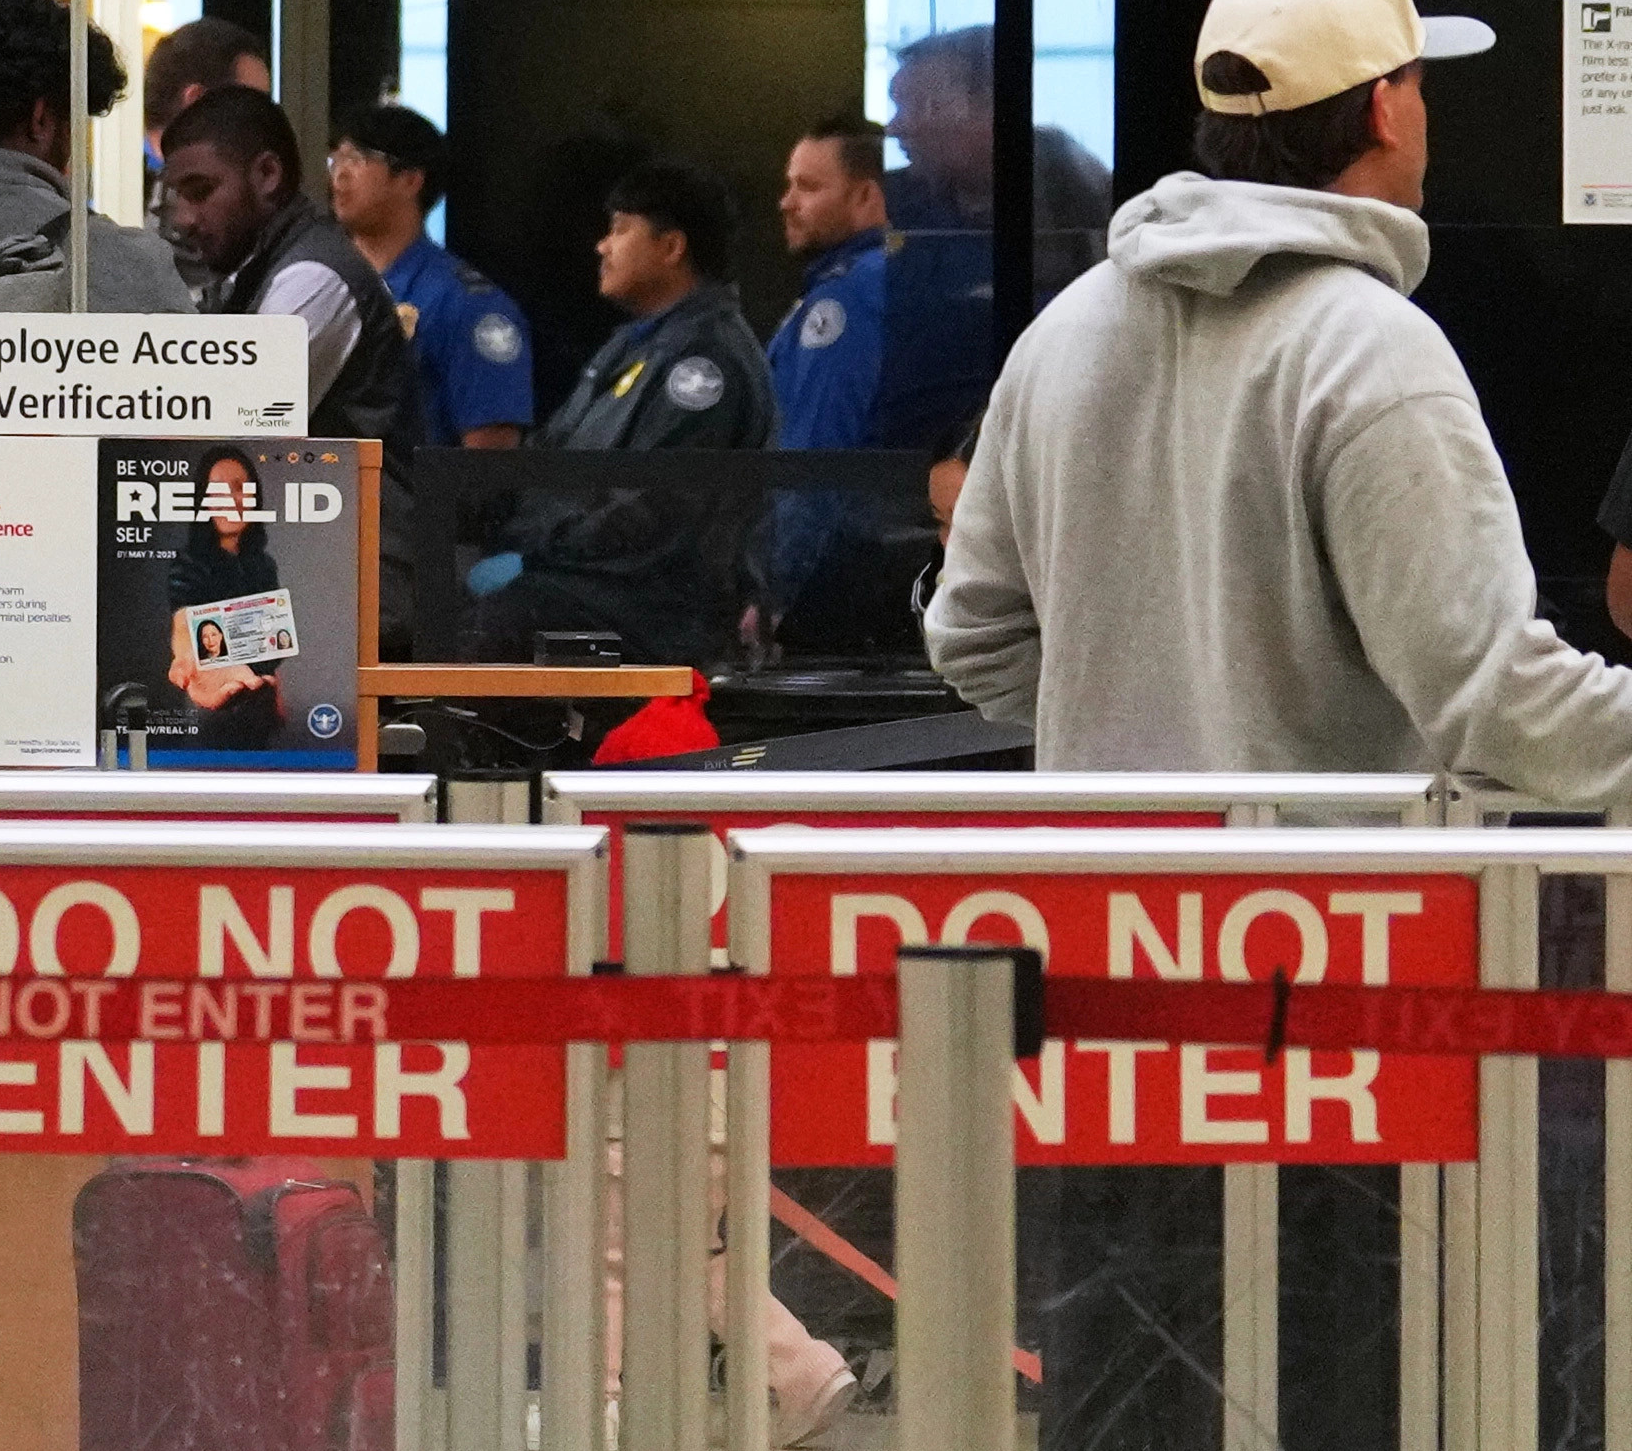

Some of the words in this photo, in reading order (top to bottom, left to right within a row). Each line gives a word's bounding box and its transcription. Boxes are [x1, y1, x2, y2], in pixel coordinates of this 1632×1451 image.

[133, 331, 258, 365] Access
[238, 407, 258, 416] Port
[244, 418, 253, 426] of
[256, 418, 291, 427] Seattle
[117, 460, 136, 476] BE
[141, 460, 189, 476] YOUR
[116, 481, 277, 523] REAL
[285, 482, 343, 523] ID
[116, 527, 152, 543] SELF
[129, 550, 146, 559] MAY
[15, 599, 47, 611] during
[27, 612, 71, 625] penalties
[200, 884, 515, 979] NOT
[1108, 890, 1423, 984] NOT
[140, 982, 389, 1040] ENTER
